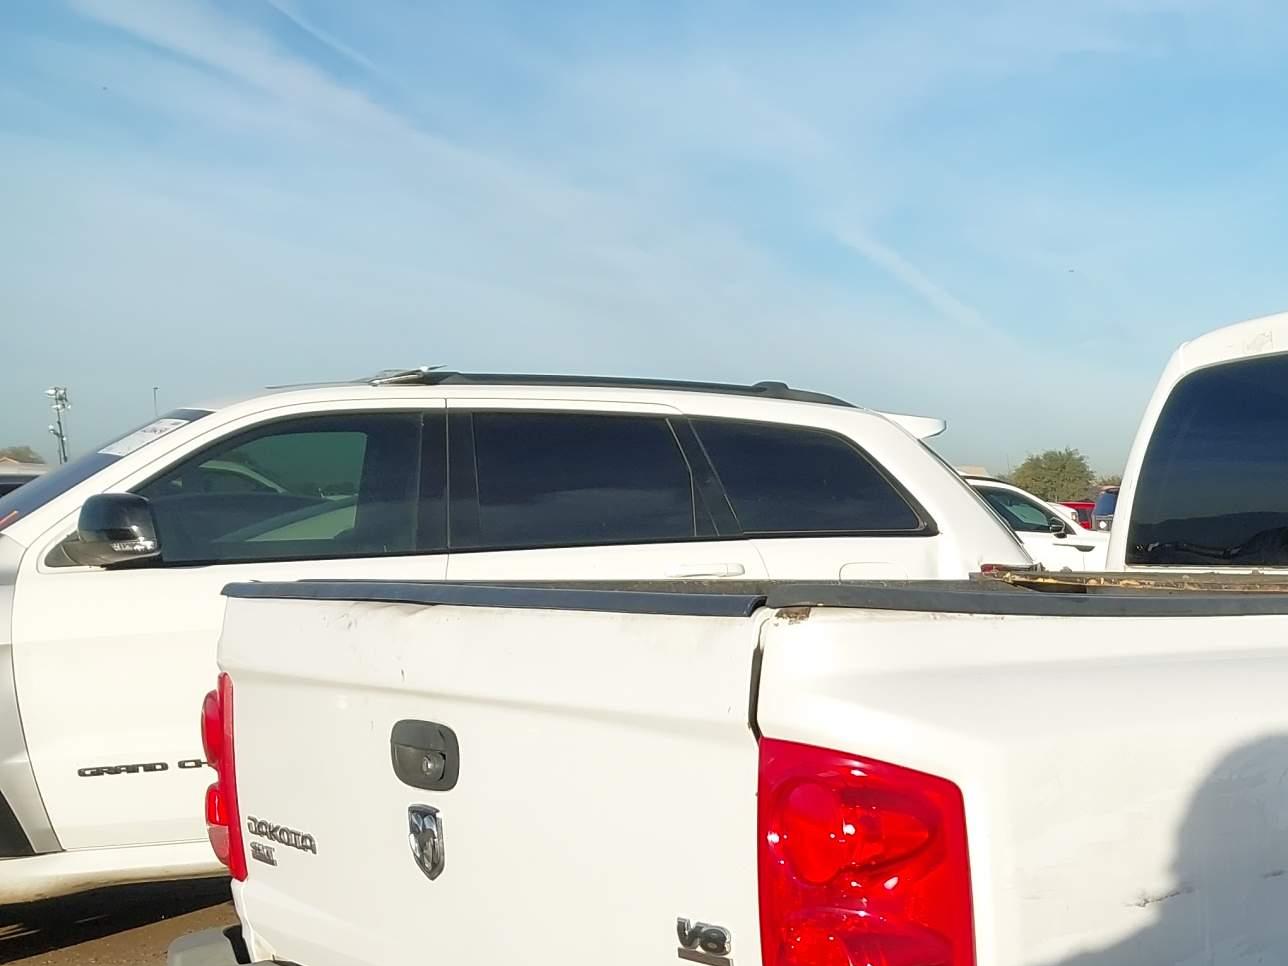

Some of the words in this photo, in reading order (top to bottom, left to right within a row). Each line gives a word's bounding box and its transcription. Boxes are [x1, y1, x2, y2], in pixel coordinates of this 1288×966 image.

[77, 762, 169, 777] GRAND
[247, 815, 317, 855] DAKOTA
[676, 916, 732, 957] V8
